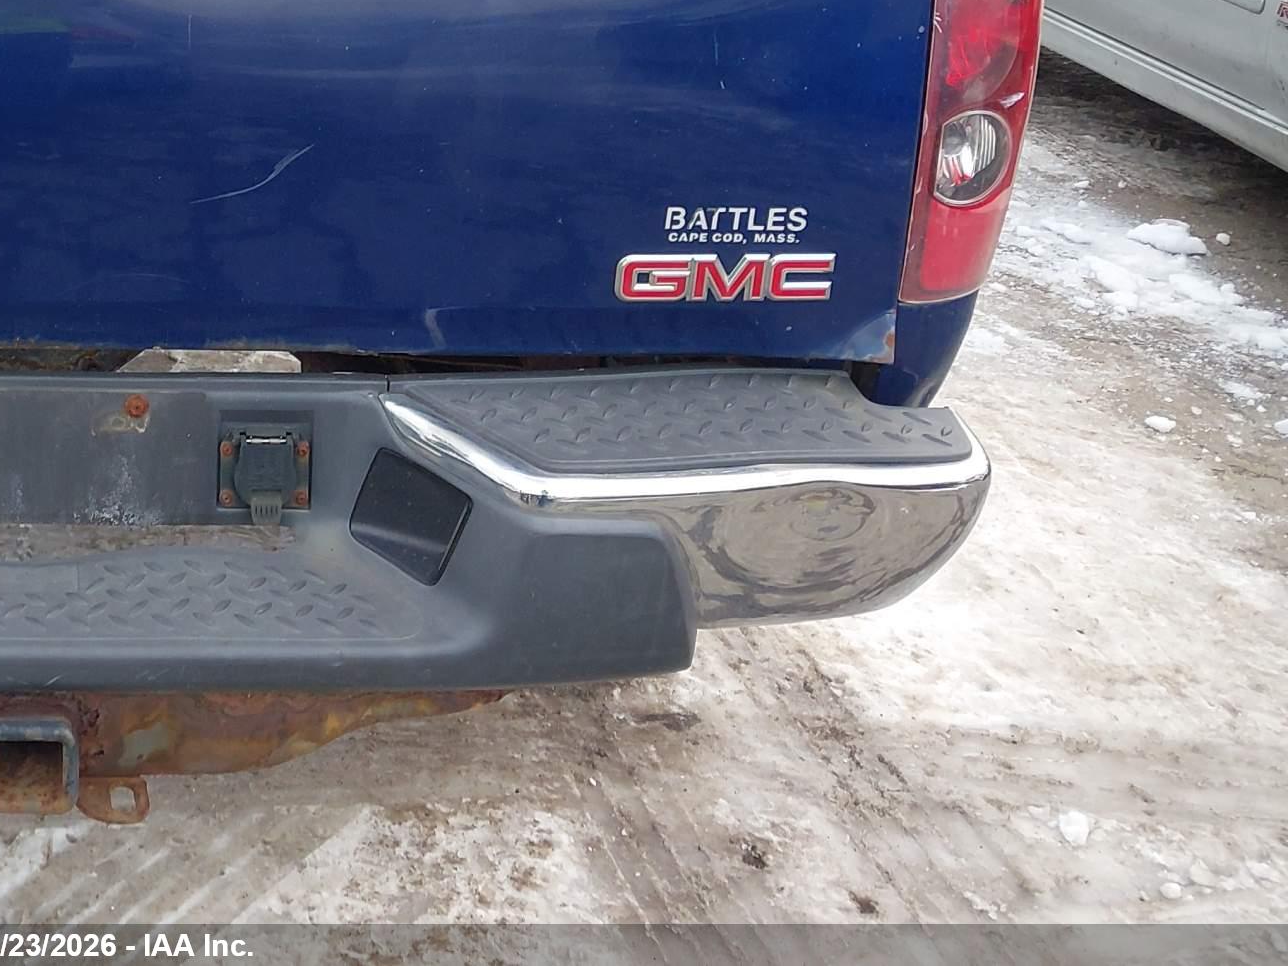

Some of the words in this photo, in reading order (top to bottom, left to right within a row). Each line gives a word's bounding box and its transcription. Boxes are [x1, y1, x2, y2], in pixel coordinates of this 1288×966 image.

[664, 206, 808, 232] BATTLES
[668, 232, 708, 243] CAPE
[711, 232, 747, 245] COD,
[753, 232, 801, 244] MASS.
[614, 253, 837, 302] GMC
